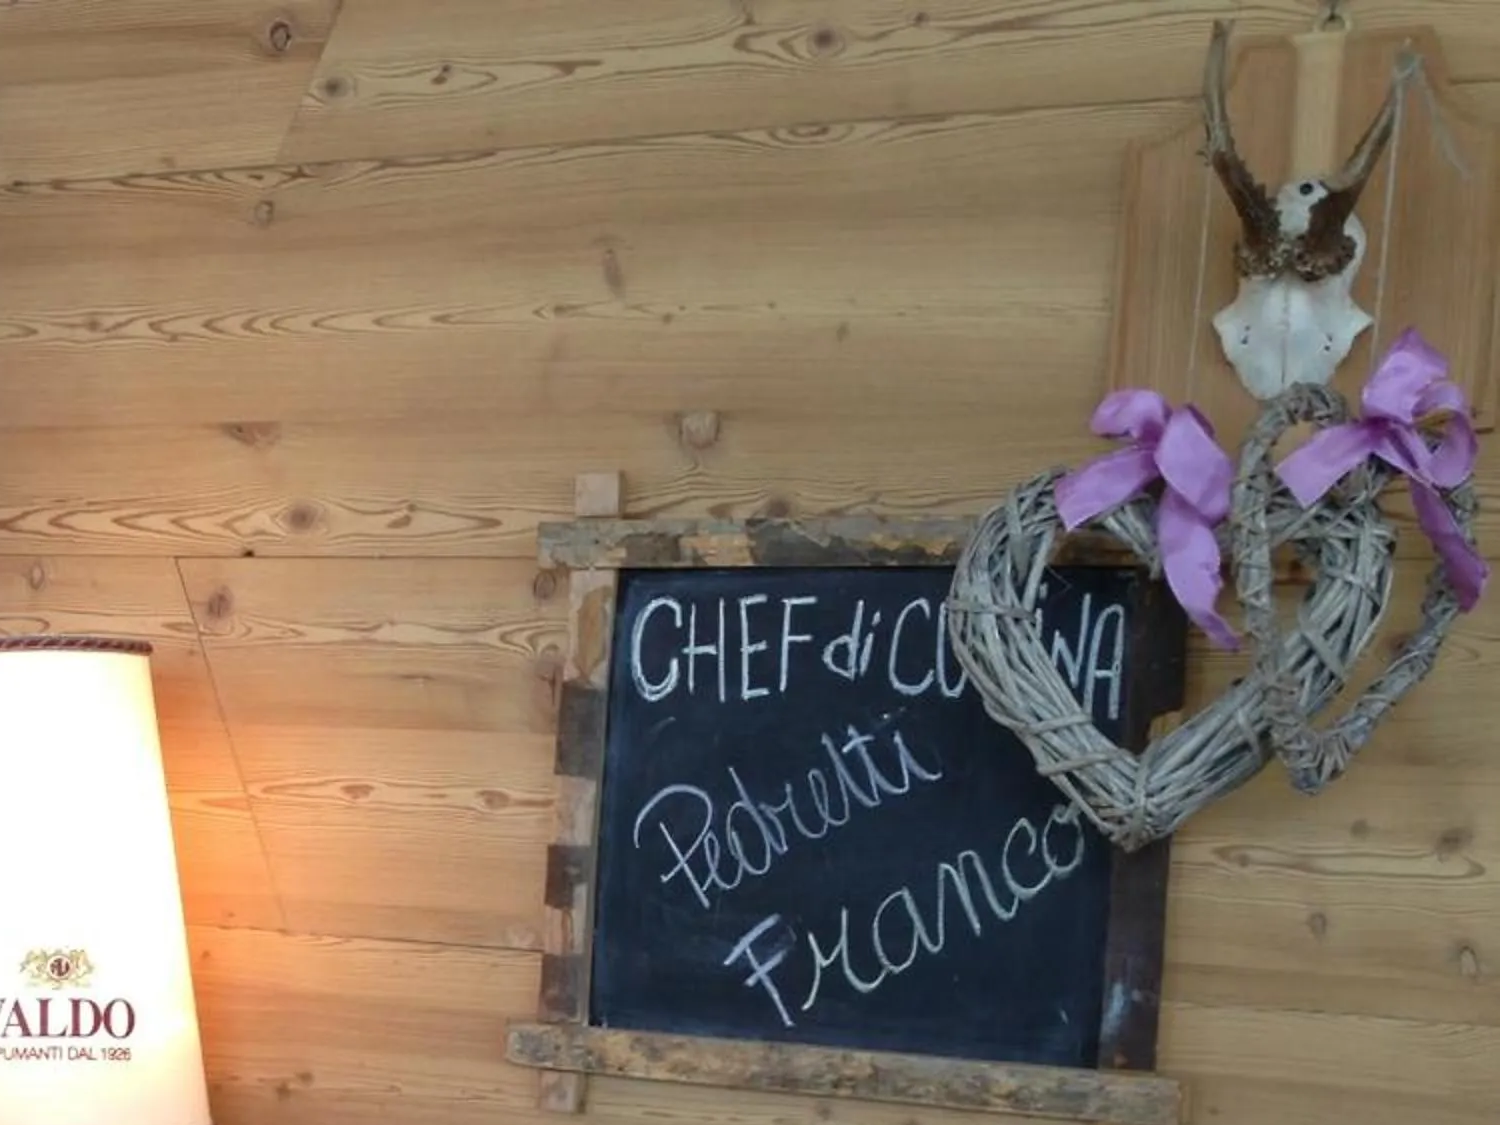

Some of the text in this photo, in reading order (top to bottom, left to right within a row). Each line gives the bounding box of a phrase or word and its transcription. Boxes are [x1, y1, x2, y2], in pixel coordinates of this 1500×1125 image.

[631, 582, 1126, 720] CHEF di CUiNA
[723, 803, 1087, 1027] Franco
[67, 1046, 98, 1061] DAL
